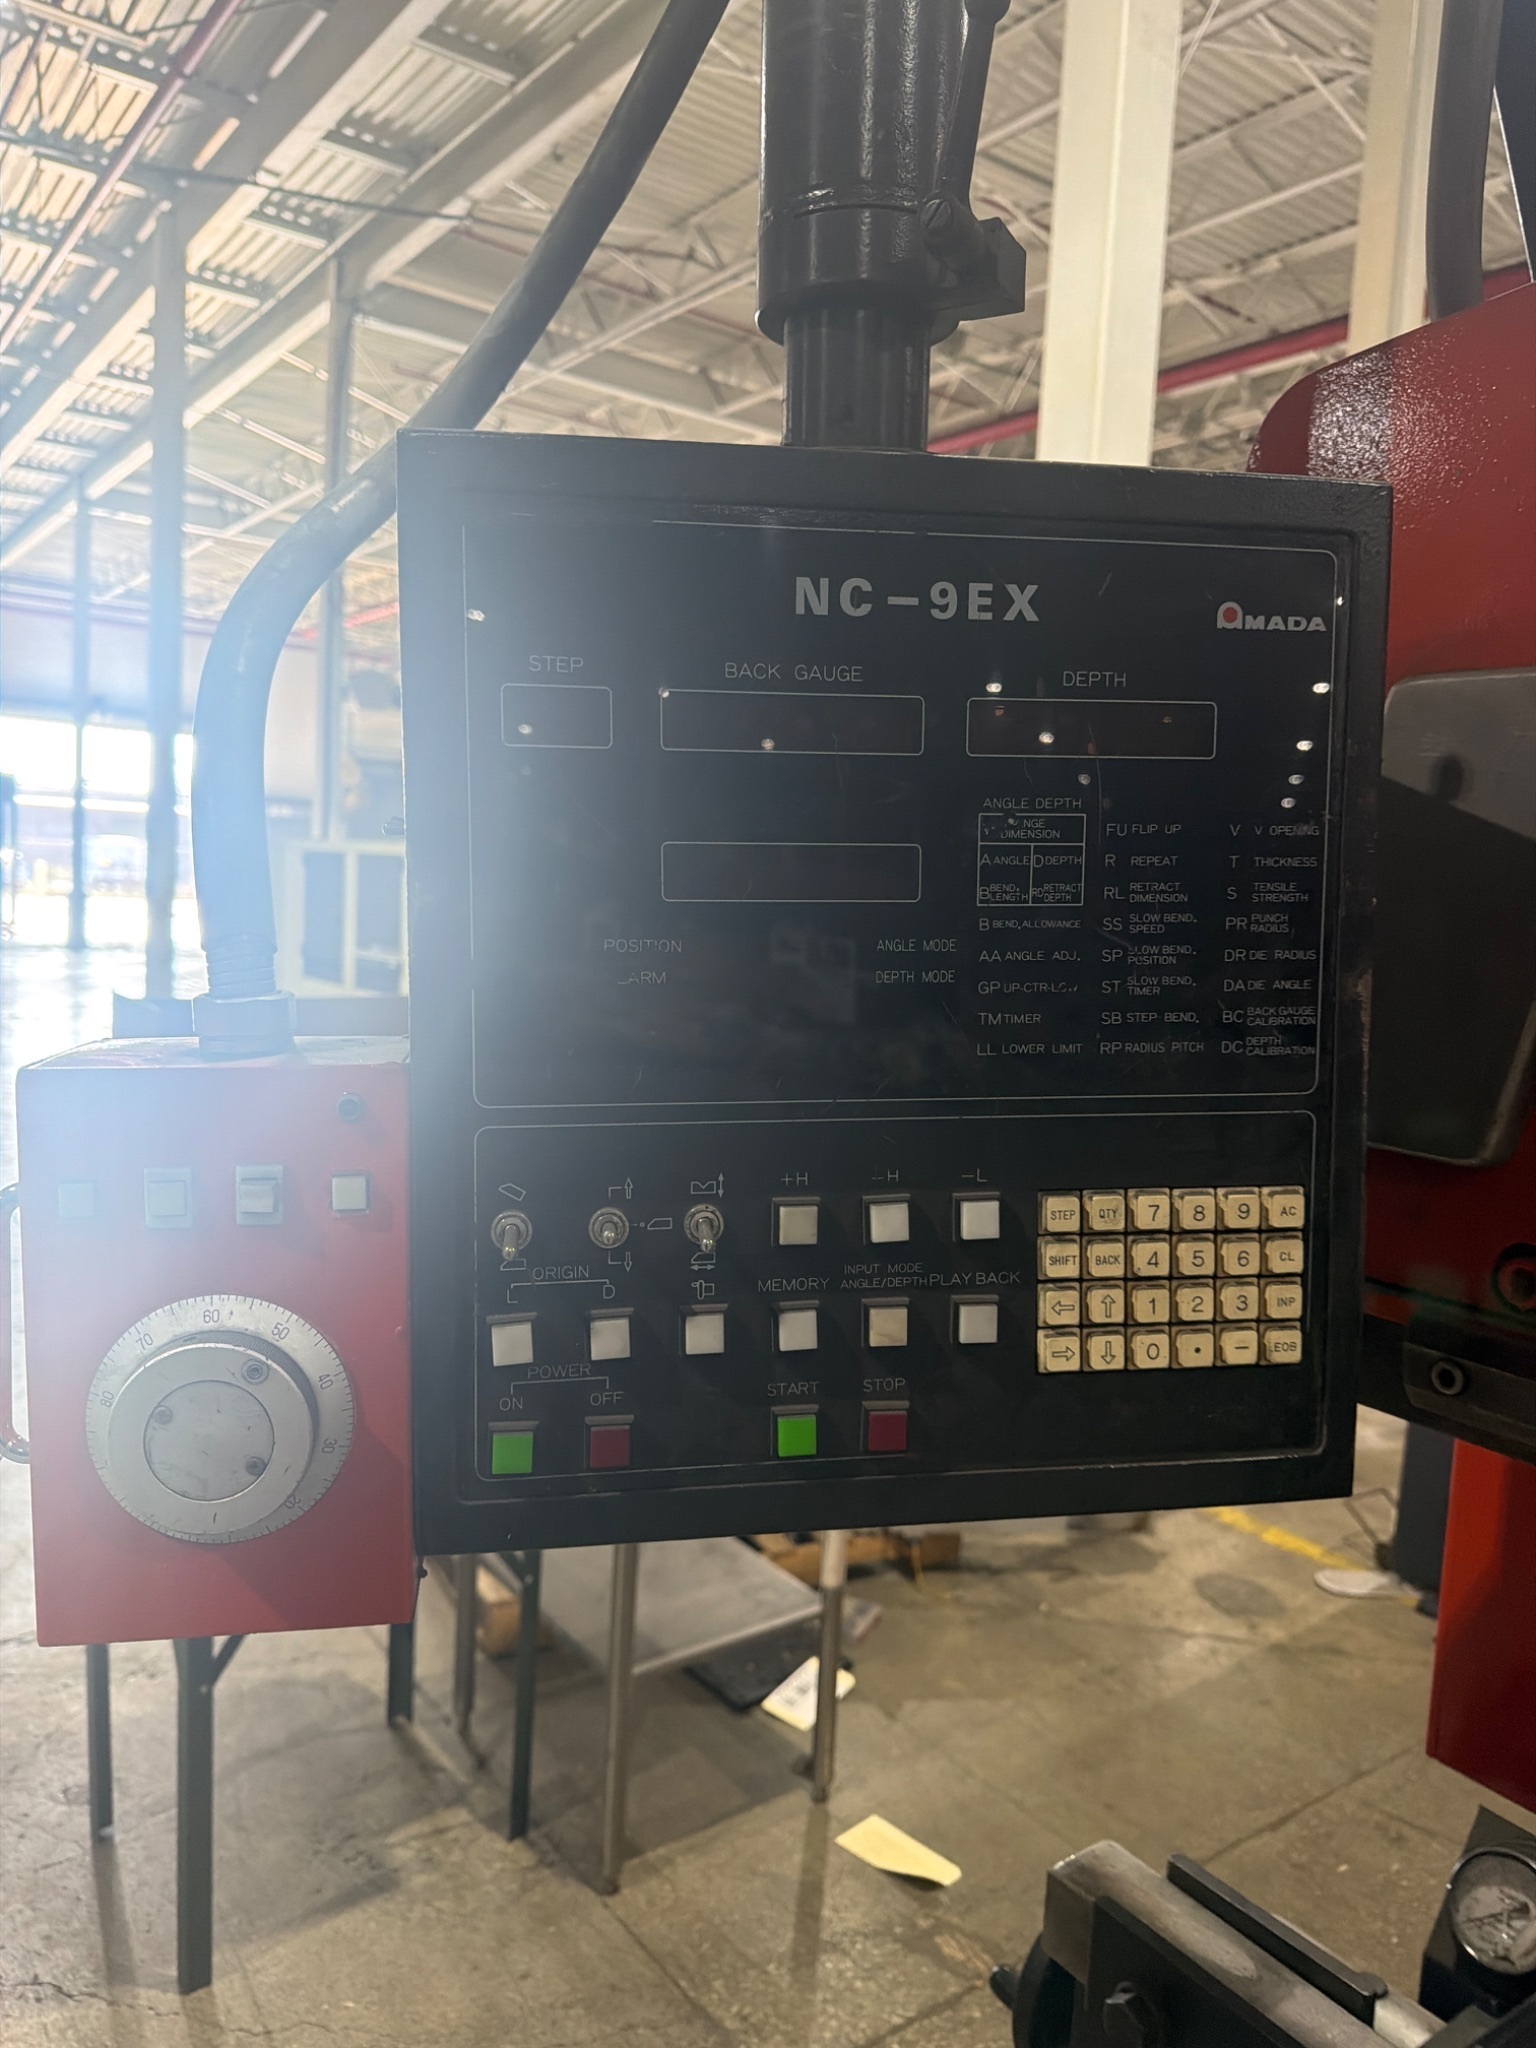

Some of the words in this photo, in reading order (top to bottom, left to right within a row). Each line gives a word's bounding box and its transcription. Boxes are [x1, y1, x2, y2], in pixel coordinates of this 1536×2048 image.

[1216, 601, 1328, 632] AMADA
[528, 654, 584, 673] STEP
[724, 662, 781, 679] BACK
[794, 664, 864, 682] GAUGE
[1062, 671, 1128, 689] DEPTH
[982, 797, 1030, 809] ANGLE
[1035, 797, 1082, 809] DEPTH
[1000, 829, 1061, 839] DIMENSION
[1106, 823, 1128, 836] FU
[1131, 824, 1158, 834] FLIP
[1164, 824, 1181, 835] UP
[1229, 824, 1240, 837] V
[980, 853, 992, 866] A
[993, 856, 1031, 866] ANGLE
[1033, 854, 1045, 868] D
[1045, 856, 1082, 866] DEPTH
[1104, 853, 1116, 867] R
[1130, 855, 1178, 867] REPEAT
[1228, 855, 1240, 868] T
[1253, 856, 1318, 867] THICKNESS
[1043, 883, 1082, 893] RETRACT
[1103, 886, 1126, 900] RL
[1129, 882, 1181, 892] RETRACT
[1226, 886, 1238, 900] S
[1253, 882, 1298, 892] TENSILE
[1043, 893, 1072, 902] DEPTH
[1129, 893, 1189, 903] DIMENSION
[1251, 893, 1310, 903] STRENGTH
[979, 917, 990, 931] B
[1102, 917, 1123, 931] SS
[1129, 913, 1161, 923] SLOW
[1163, 913, 1198, 923] BEND.
[1129, 924, 1166, 934] SPEED
[1225, 916, 1249, 931] PR
[1250, 913, 1289, 923] PUNCH
[1249, 923, 1290, 934] RADIUS
[877, 939, 917, 952] ANGLE
[922, 939, 957, 952] MODE
[978, 950, 1002, 963] AA
[1004, 951, 1046, 961] ANGLE
[1051, 950, 1082, 962] ADJ.
[1101, 949, 1124, 963] SP
[1127, 945, 1160, 955] SLOW
[1162, 945, 1198, 955] BEND.
[1127, 955, 1178, 965] POSITION
[1224, 949, 1247, 962] DR
[1249, 950, 1268, 960] DIE
[1274, 949, 1318, 960] RADIUS
[875, 970, 915, 984] DEPTH
[921, 970, 956, 983] MODE
[977, 981, 1001, 995] GP
[1101, 980, 1121, 994] ST
[1127, 975, 1160, 986] SLOW
[1161, 976, 1198, 987] BEND.
[1127, 986, 1161, 996] TIMER
[1223, 979, 1246, 992] DA
[1247, 980, 1267, 990] DIE
[1272, 979, 1312, 990] ANGLE
[977, 1012, 1002, 1026] TM
[1003, 1013, 1042, 1025] TIMER
[1101, 1011, 1123, 1025] SB
[1126, 1012, 1158, 1023] STEP
[1163, 1012, 1200, 1024] BEND.
[1222, 1010, 1244, 1024] BC
[1246, 1007, 1277, 1016] BACK
[1278, 1006, 1316, 1016] GAUGE
[1246, 1016, 1316, 1027] CALIBRATION
[977, 1042, 998, 1056] LL
[1001, 1043, 1046, 1055] LOWER
[1051, 1043, 1084, 1055] LIMIT
[1100, 1041, 1123, 1055] RP
[1125, 1042, 1166, 1054] RADIUS
[1171, 1041, 1205, 1053] PITCH
[1221, 1040, 1244, 1054] DC
[1245, 1036, 1283, 1046] DEPTH
[1245, 1046, 1316, 1057] CALIBRATION
[1050, 1210, 1076, 1221] STEP
[1098, 1209, 1118, 1219] QTY
[1147, 1205, 1160, 1222] 7
[1193, 1205, 1206, 1222] 8
[1237, 1203, 1251, 1220] 9
[1279, 1206, 1297, 1217] AC
[1048, 1255, 1078, 1266] SHIFT
[1094, 1255, 1121, 1266] BACK
[1146, 1251, 1160, 1268] 4
[1191, 1250, 1205, 1268] 5
[1237, 1251, 1250, 1268] 6
[1278, 1252, 1295, 1263] CL
[532, 1265, 590, 1281] ORIGIN
[843, 1264, 881, 1275] INPUT
[887, 1263, 924, 1274] MODE
[757, 1278, 830, 1292] MEMORY
[840, 1276, 929, 1290] ANGLE/DEPTH
[929, 1272, 972, 1287] PLAY
[976, 1271, 1022, 1286] BACK
[602, 1284, 616, 1299] D
[1148, 1298, 1156, 1316] 1
[1191, 1296, 1205, 1313] 2
[1235, 1295, 1249, 1312] 3
[1276, 1297, 1296, 1308] INP
[202, 1309, 221, 1324] 60
[271, 1321, 291, 1341] 50
[135, 1332, 155, 1351] 70
[526, 1363, 592, 1380] POWER
[317, 1372, 334, 1391] 40
[767, 1381, 820, 1396] START
[862, 1377, 906, 1393] STOP
[100, 1390, 115, 1409] 80
[499, 1397, 524, 1411] ON
[589, 1391, 624, 1406] OFF
[321, 1437, 338, 1455] 30
